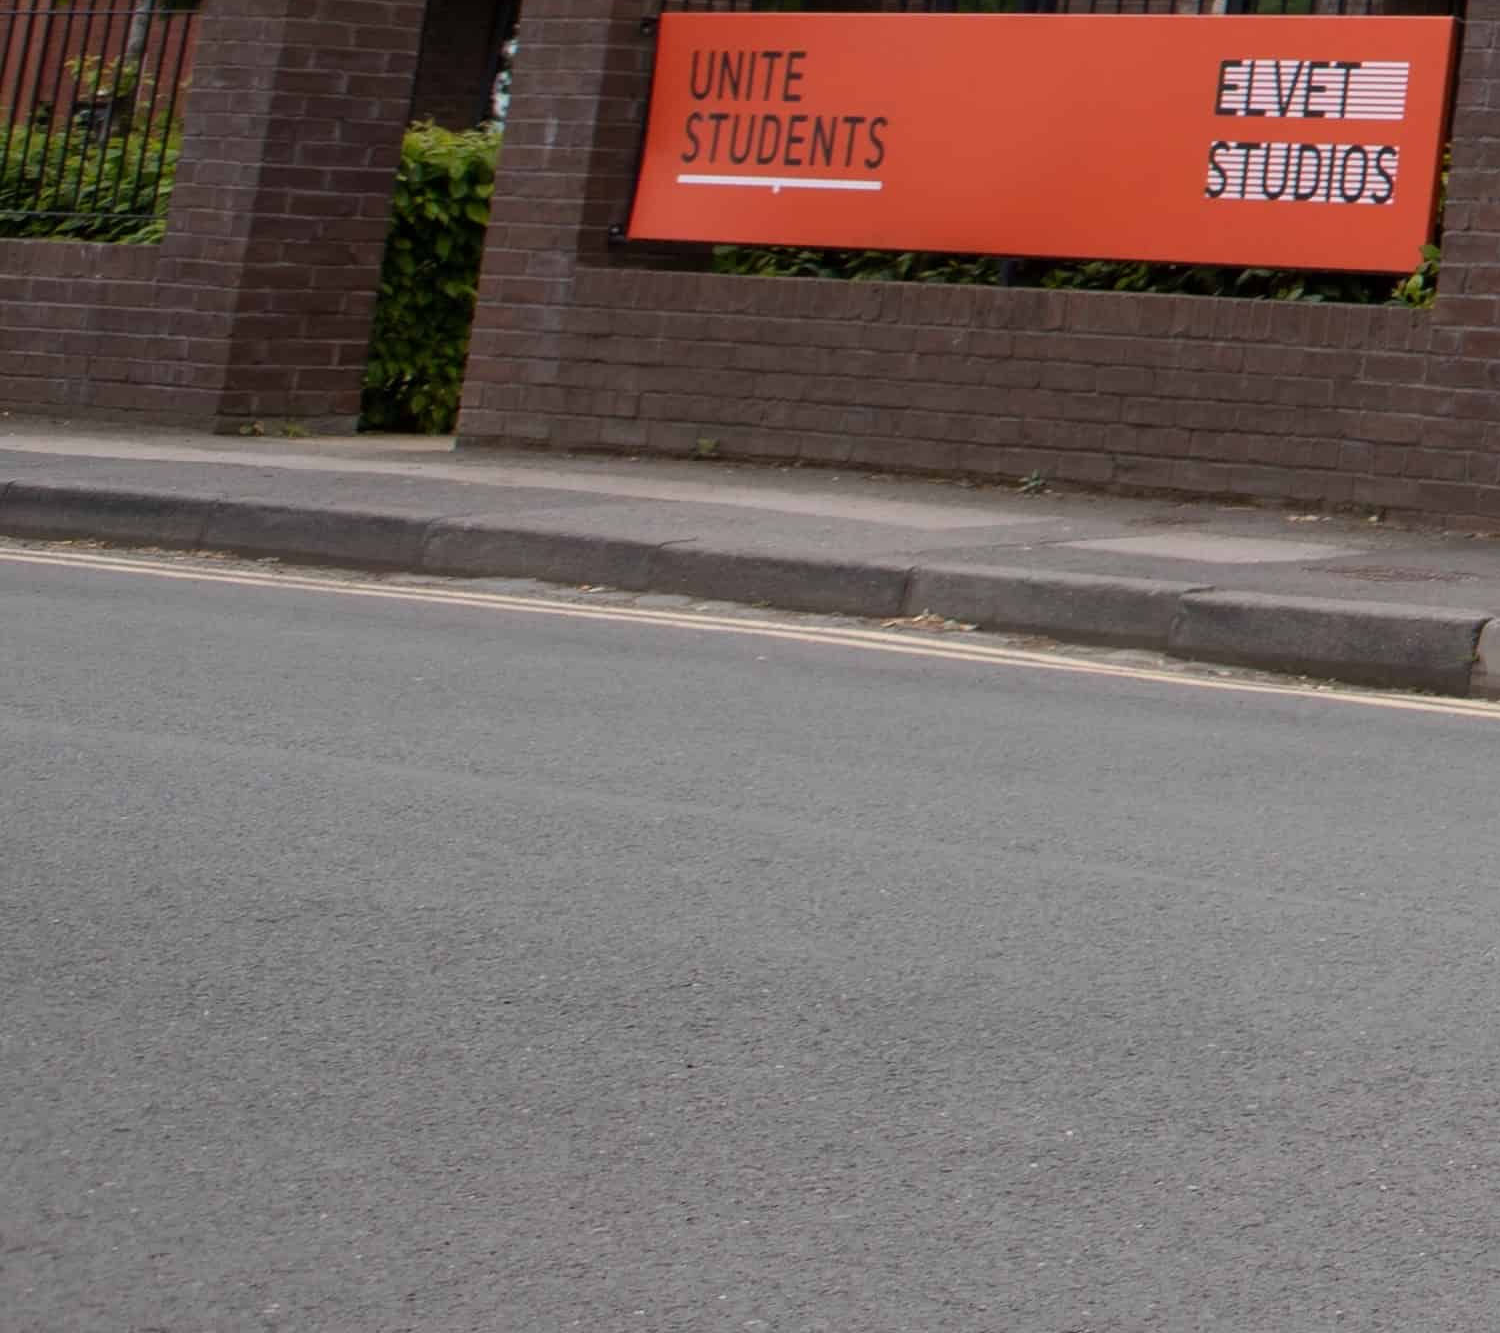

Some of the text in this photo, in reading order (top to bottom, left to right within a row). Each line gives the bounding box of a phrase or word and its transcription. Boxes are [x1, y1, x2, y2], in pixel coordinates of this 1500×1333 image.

[689, 49, 807, 102] UNITE
[1215, 59, 1362, 119] ELVET
[681, 111, 889, 170] STUDENTS
[1204, 140, 1398, 204] STUDIOS
